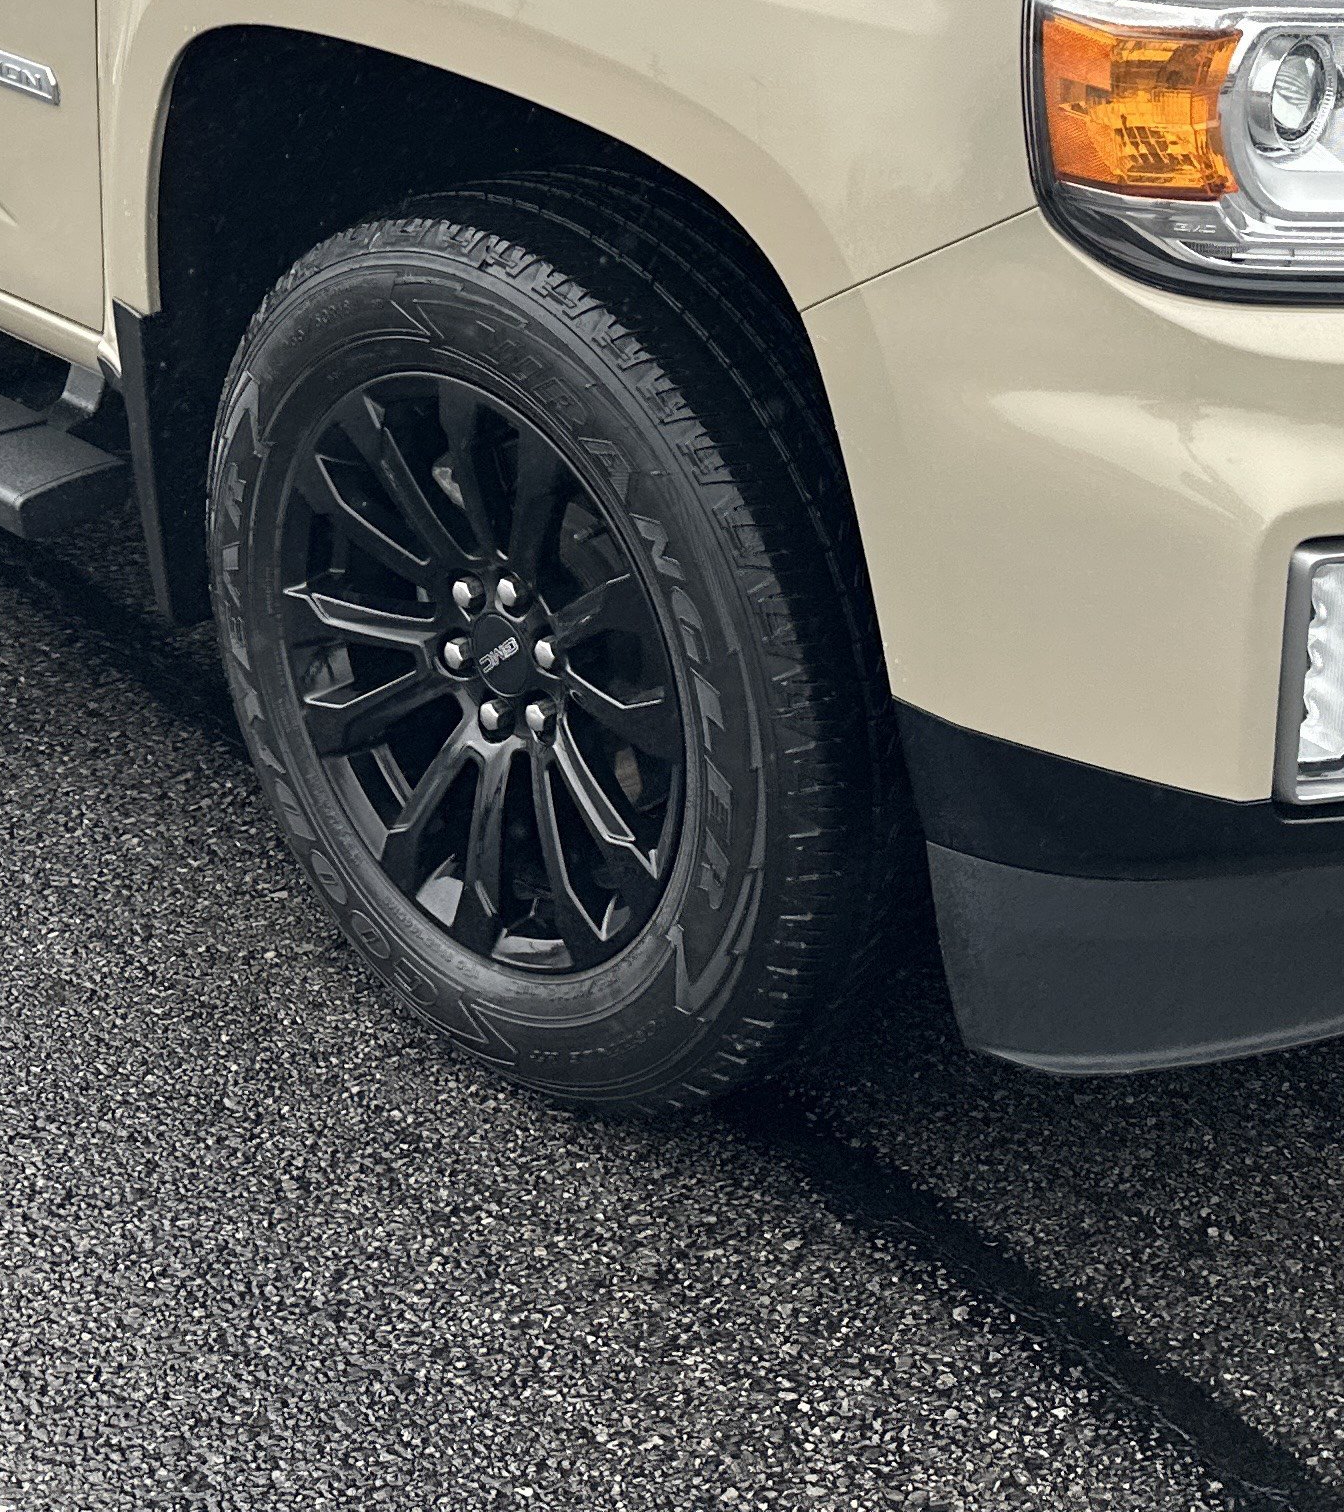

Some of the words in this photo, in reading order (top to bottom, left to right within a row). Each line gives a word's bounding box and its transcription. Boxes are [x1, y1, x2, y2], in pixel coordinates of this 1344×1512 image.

[221, 462, 440, 1007] GOODYEAR
[473, 318, 733, 910] WRANGLER
[478, 636, 519, 674] GMC
